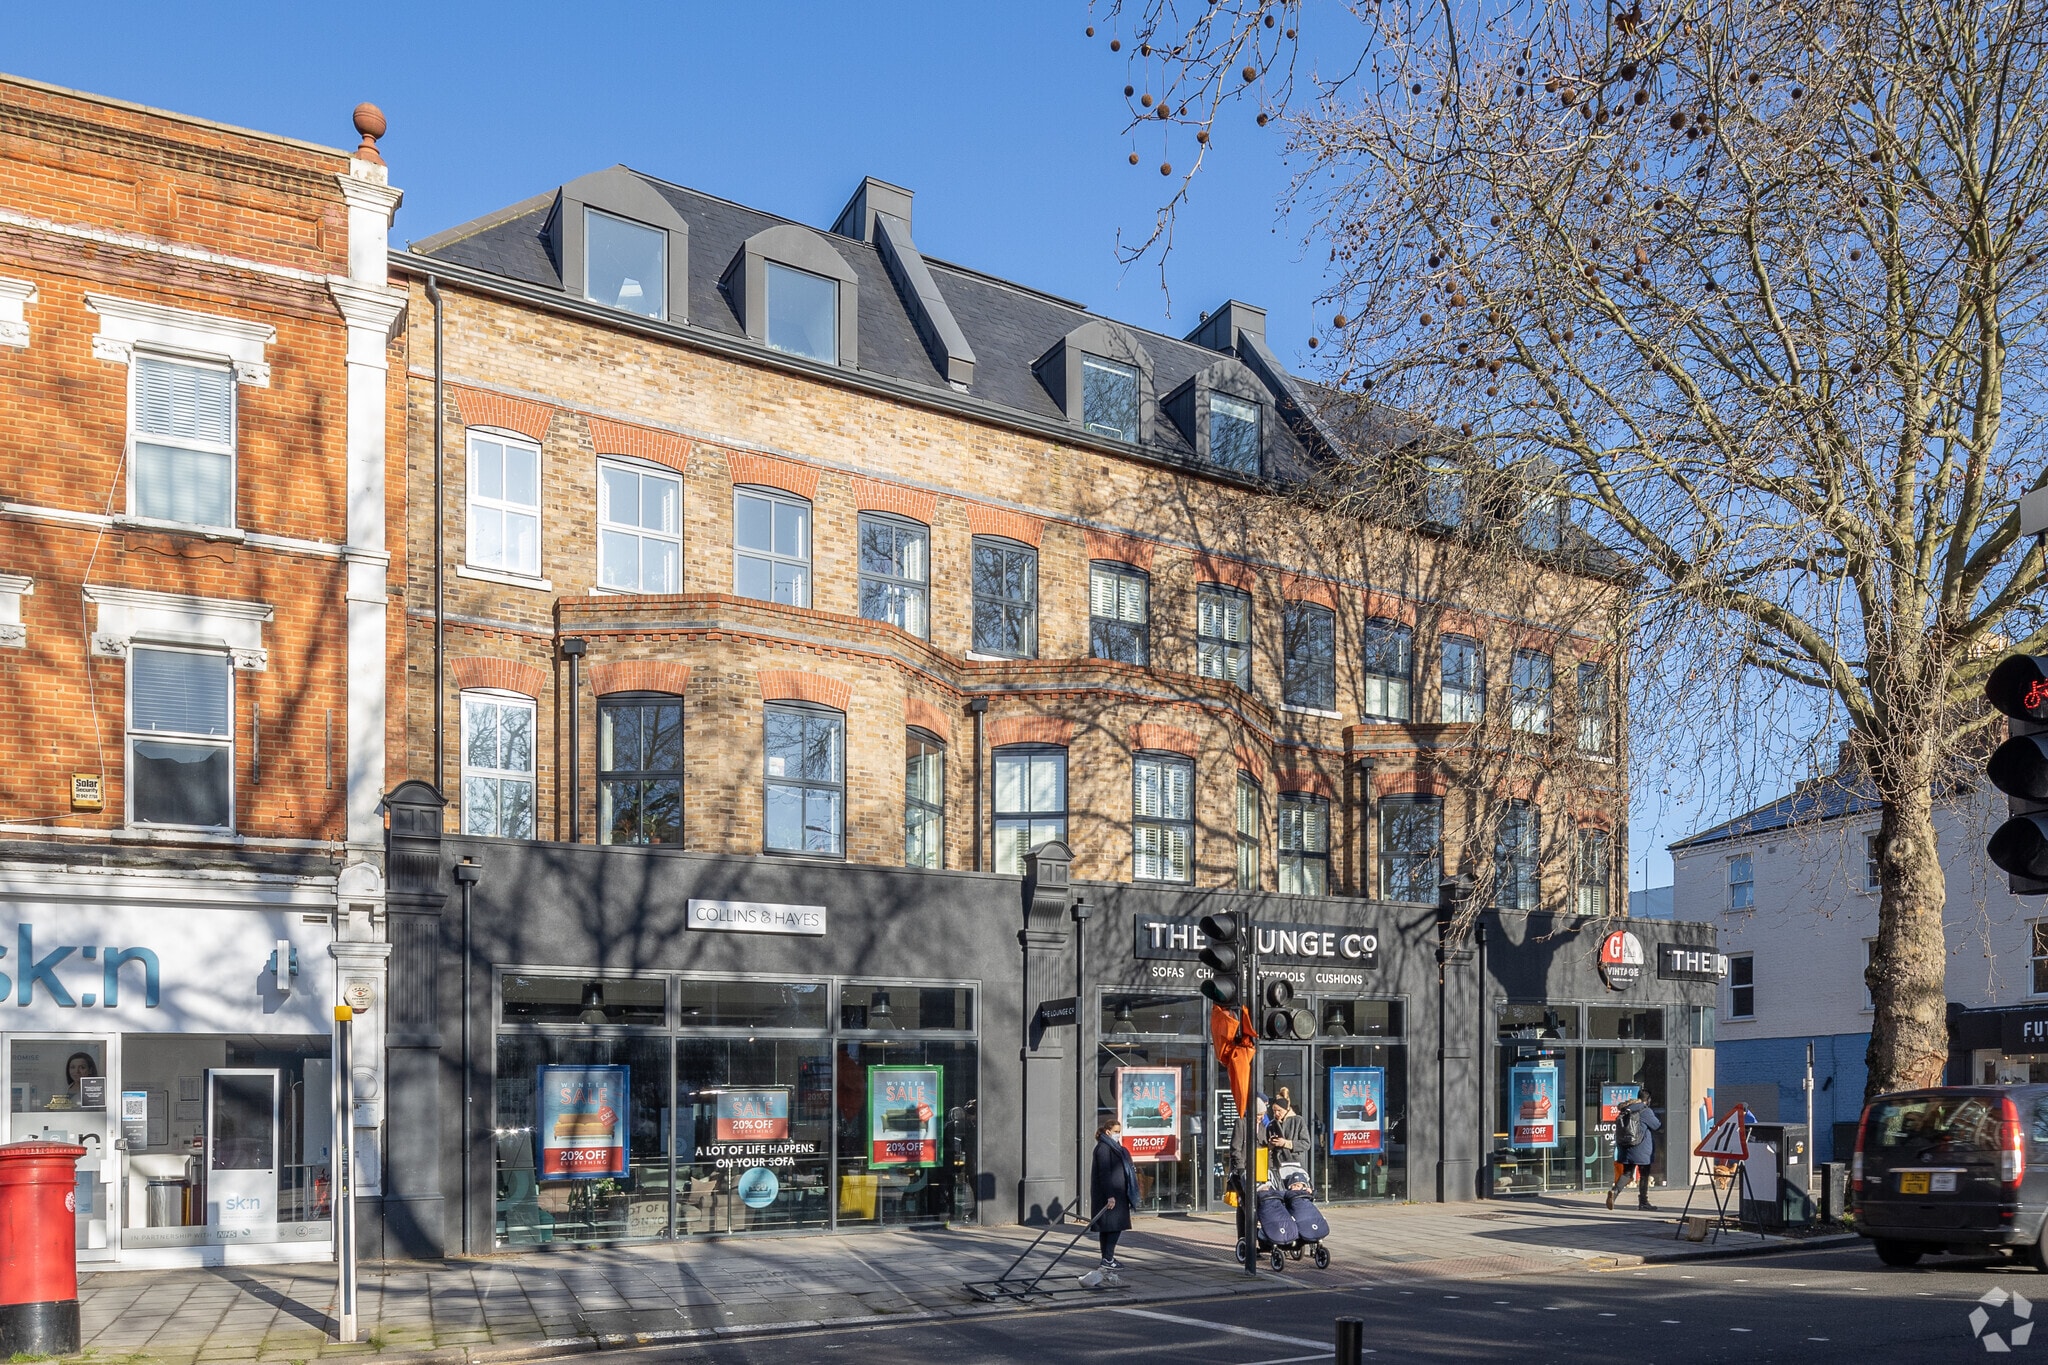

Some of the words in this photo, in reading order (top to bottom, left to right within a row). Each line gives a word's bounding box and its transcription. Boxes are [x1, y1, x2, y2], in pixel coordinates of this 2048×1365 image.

[76, 779, 98, 788] Solar
[696, 907, 757, 923] COLLINS
[760, 910, 771, 924] &
[775, 911, 819, 927] HAYES
[1146, 922, 1207, 951] THE
[1241, 926, 1336, 957] UNGE
[1609, 936, 1621, 958] G
[0, 923, 160, 1008] k:n
[1670, 950, 1711, 973] THE
[1152, 966, 1185, 978] SOFAS
[1315, 971, 1363, 985] CUSHIONS
[1607, 966, 1639, 977] VINTAGE
[886, 1086, 925, 1101] SALE
[1133, 1086, 1166, 1101] SALE
[1343, 1085, 1371, 1098] SALE
[1522, 1083, 1546, 1095] SALE
[560, 1088, 608, 1105] SALE
[733, 1102, 773, 1117] SALE
[733, 1121, 753, 1130] 20%
[754, 1120, 773, 1129] OFF
[1133, 1138, 1149, 1147] 20%
[1150, 1137, 1165, 1146] OFF
[1343, 1133, 1357, 1141] 20%
[1357, 1132, 1371, 1140] OFF
[695, 1147, 703, 1156] A
[706, 1146, 726, 1156] LOT
[729, 1145, 743, 1155] OF
[746, 1145, 766, 1155] LIFE
[769, 1143, 815, 1154] HAPPENS
[886, 1142, 905, 1152] 20%
[906, 1142, 924, 1151] OFF
[560, 1151, 584, 1161] 20%
[585, 1150, 607, 1160] OFF
[716, 1158, 733, 1168] ON
[736, 1157, 766, 1168] YOUR
[768, 1157, 795, 1167] SOFA
[226, 1195, 260, 1210] sk:n
[141, 1233, 192, 1241] PARTNERSHIP
[217, 1230, 237, 1238] NHS
